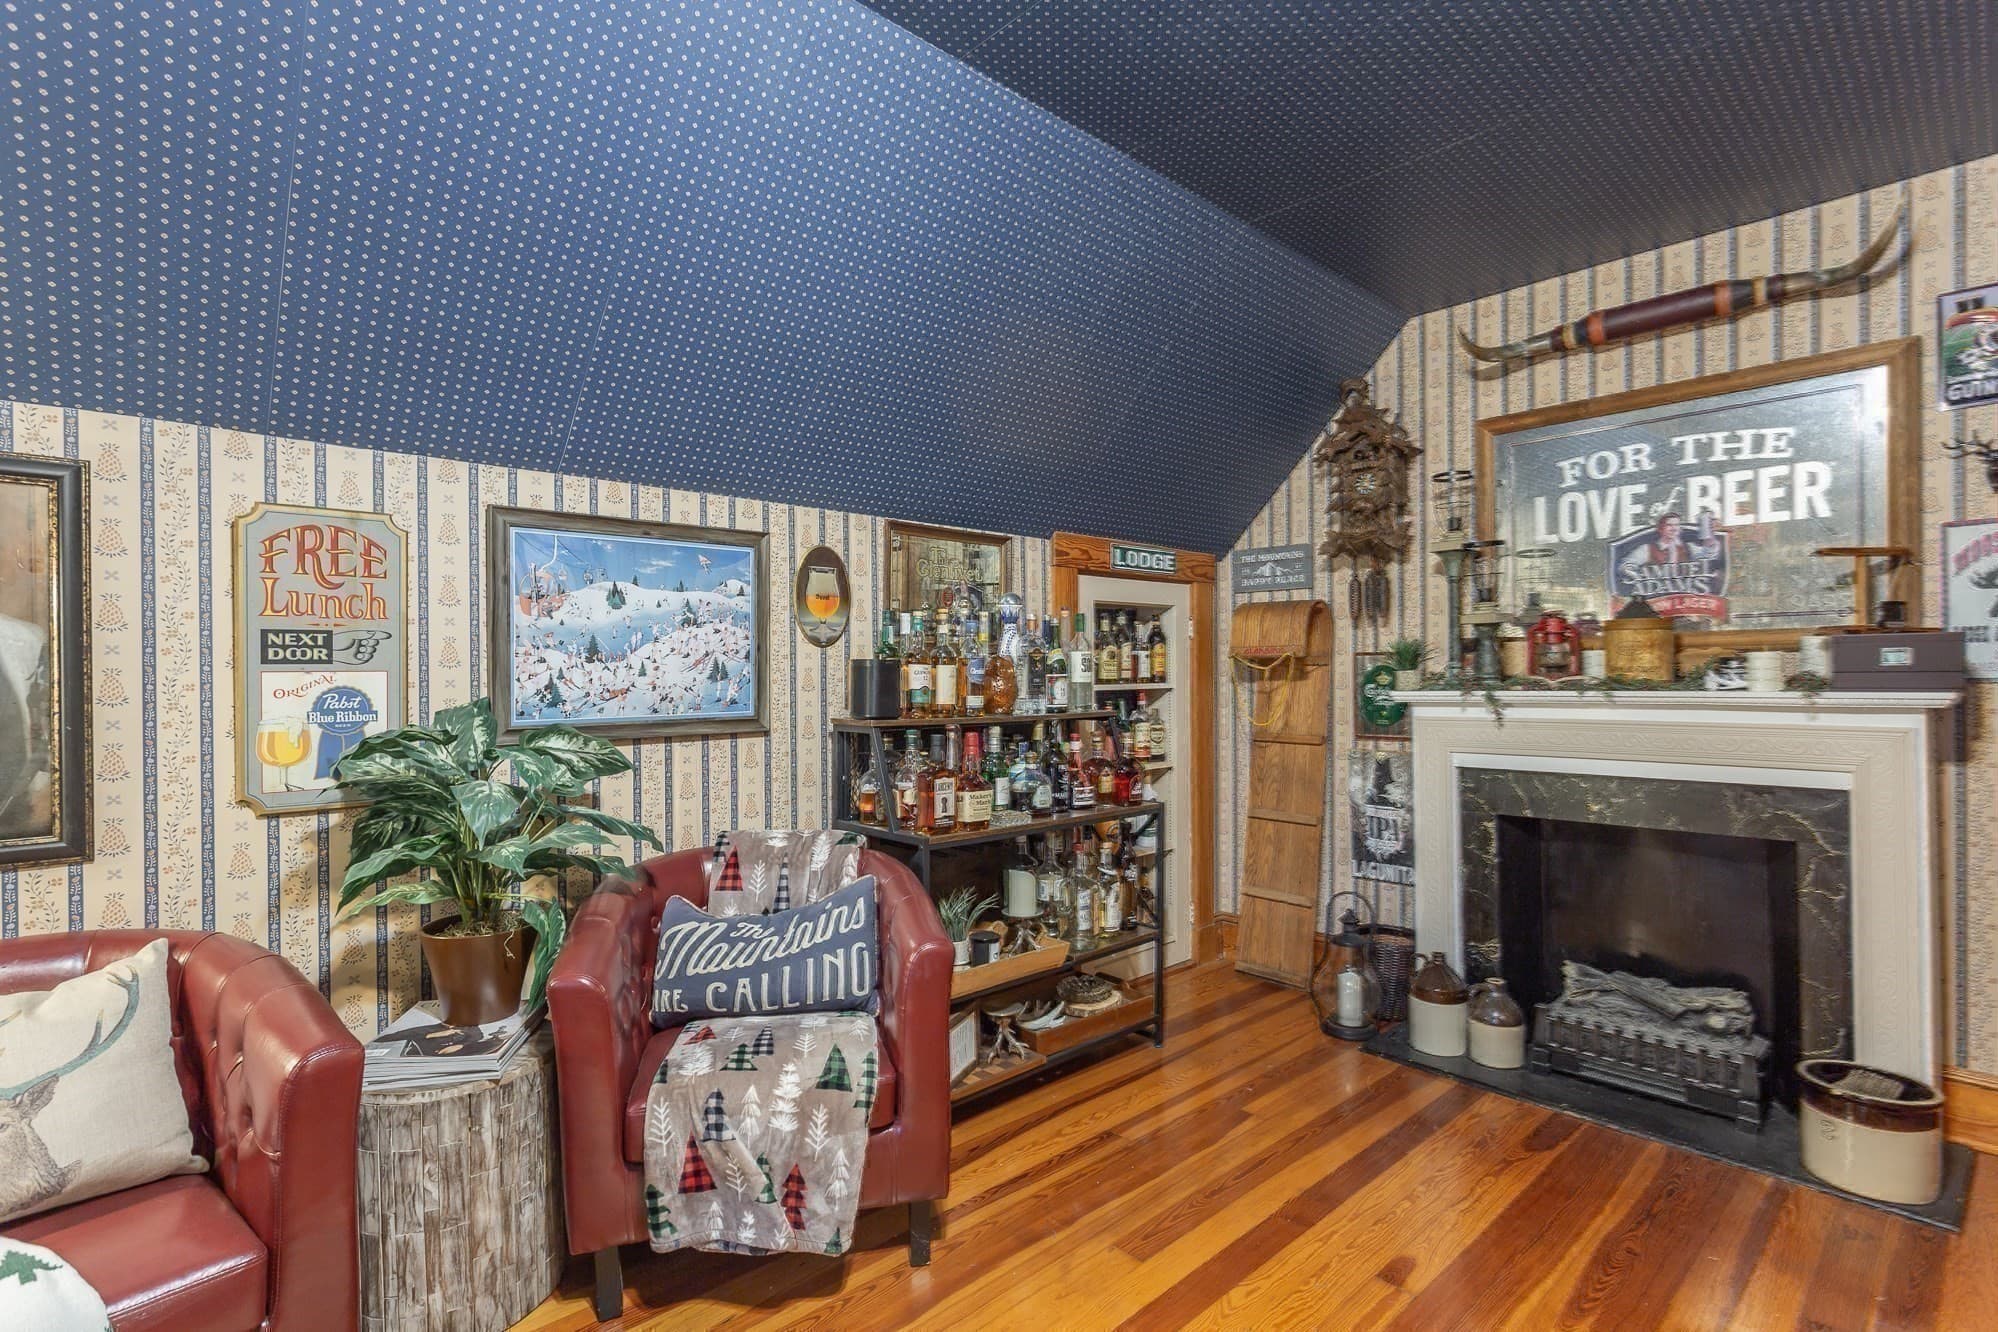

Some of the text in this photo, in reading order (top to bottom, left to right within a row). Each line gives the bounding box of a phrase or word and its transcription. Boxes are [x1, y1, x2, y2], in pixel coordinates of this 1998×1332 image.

[1555, 426, 1796, 488] FOR THE
[1534, 460, 1833, 544] LOVE of BEER
[258, 523, 388, 589] FREE
[1113, 547, 1176, 572] LODGE
[916, 558, 983, 582] Glenlivet
[1620, 558, 1718, 581] SAMUEL
[1624, 576, 1710, 595] ADAMS
[258, 577, 389, 621] Lunch
[267, 631, 328, 646] NEXT
[267, 647, 329, 661] DOOR
[273, 673, 336, 699] ORIGINAL
[322, 692, 363, 710] Pabst
[308, 710, 377, 723] Blue Ribbon
[654, 896, 866, 980] Mountains
[729, 921, 775, 939] The
[704, 941, 871, 1014] CALLING
